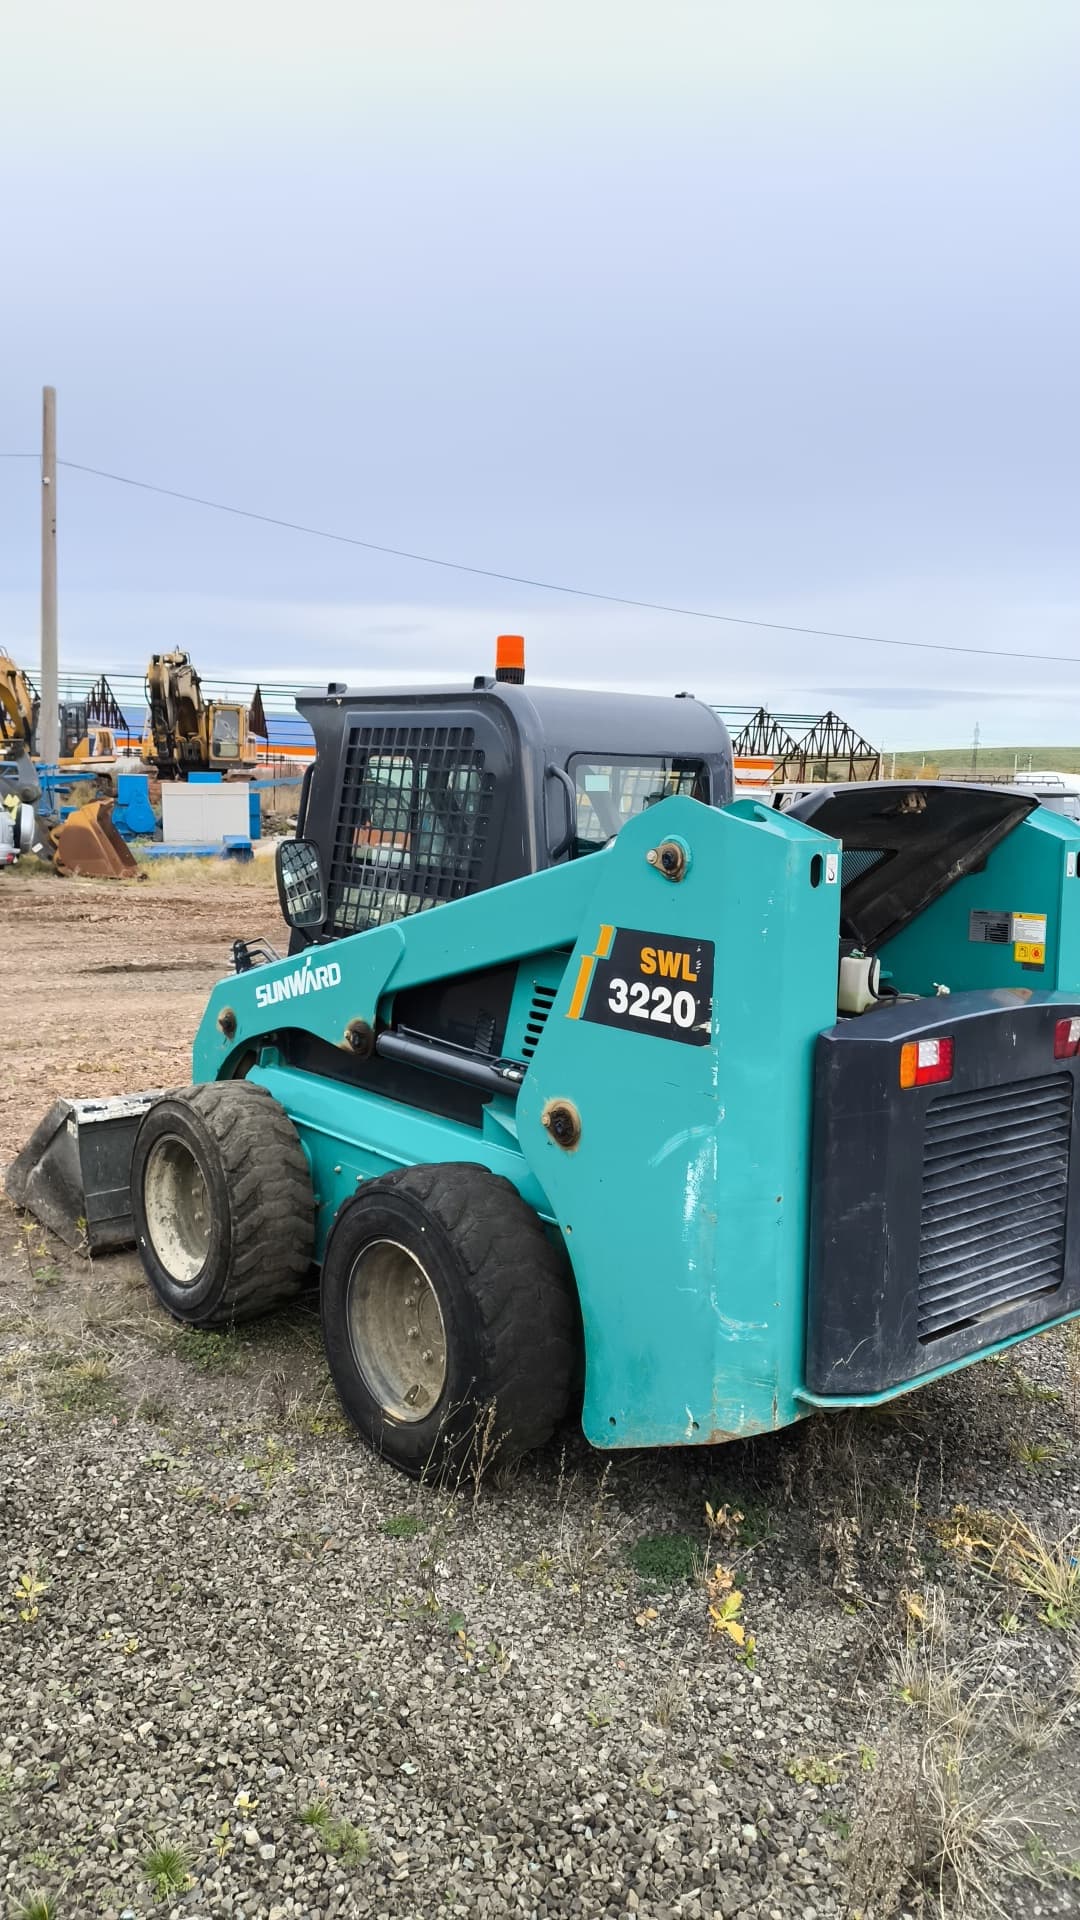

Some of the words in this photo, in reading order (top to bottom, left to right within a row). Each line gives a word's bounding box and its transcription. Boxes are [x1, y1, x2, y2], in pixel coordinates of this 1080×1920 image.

[256, 956, 341, 1008] SUNWARD
[640, 947, 697, 982] SWL
[608, 978, 695, 1028] 3220
